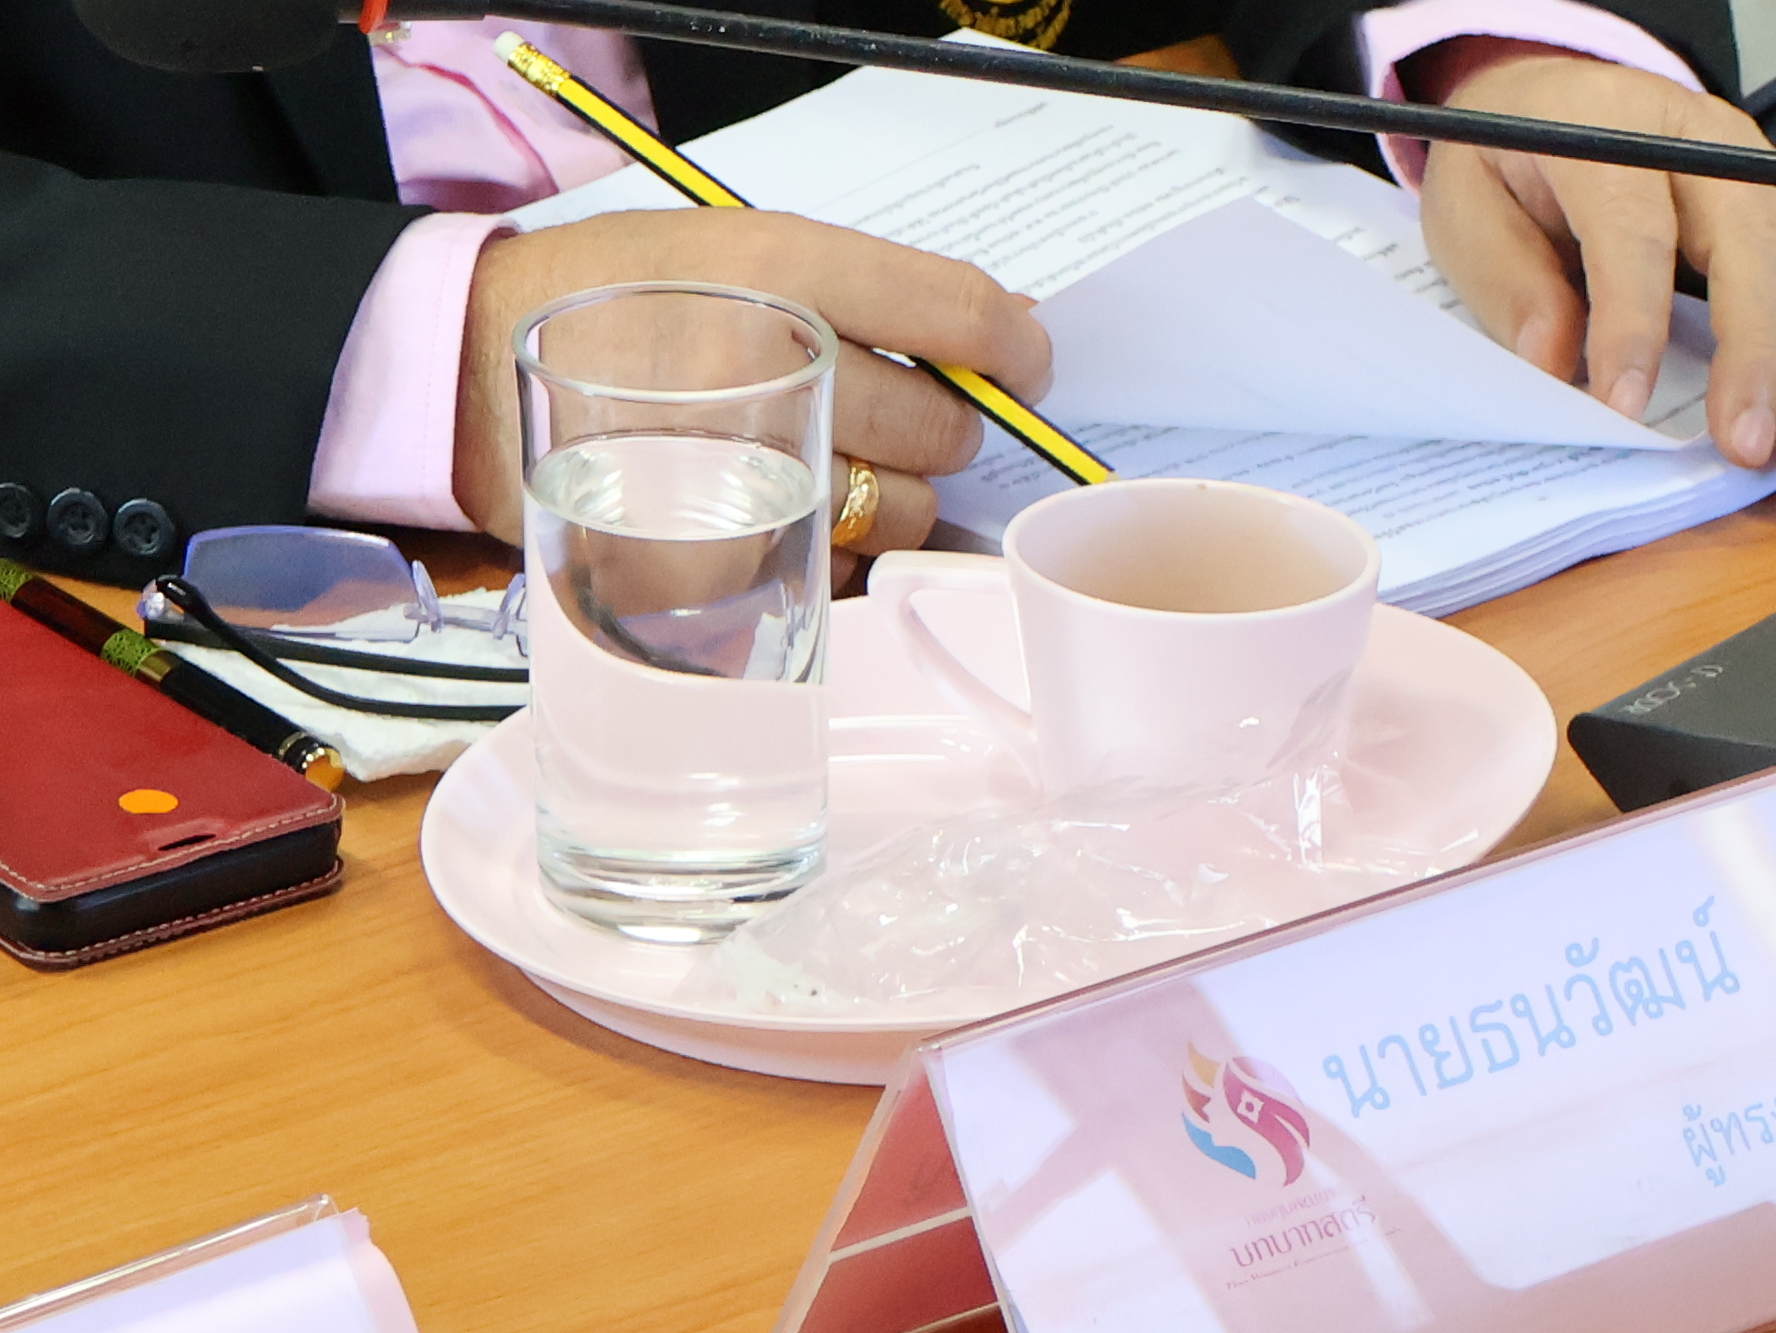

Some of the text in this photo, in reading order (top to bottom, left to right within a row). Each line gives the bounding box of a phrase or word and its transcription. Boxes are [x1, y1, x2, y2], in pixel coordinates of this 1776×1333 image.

[1322, 895, 1741, 1121] นายธนวัฒน์
[1682, 1101, 1776, 1189] ผู้ทร
[1228, 1194, 1377, 1269] บทบาทสตรี
